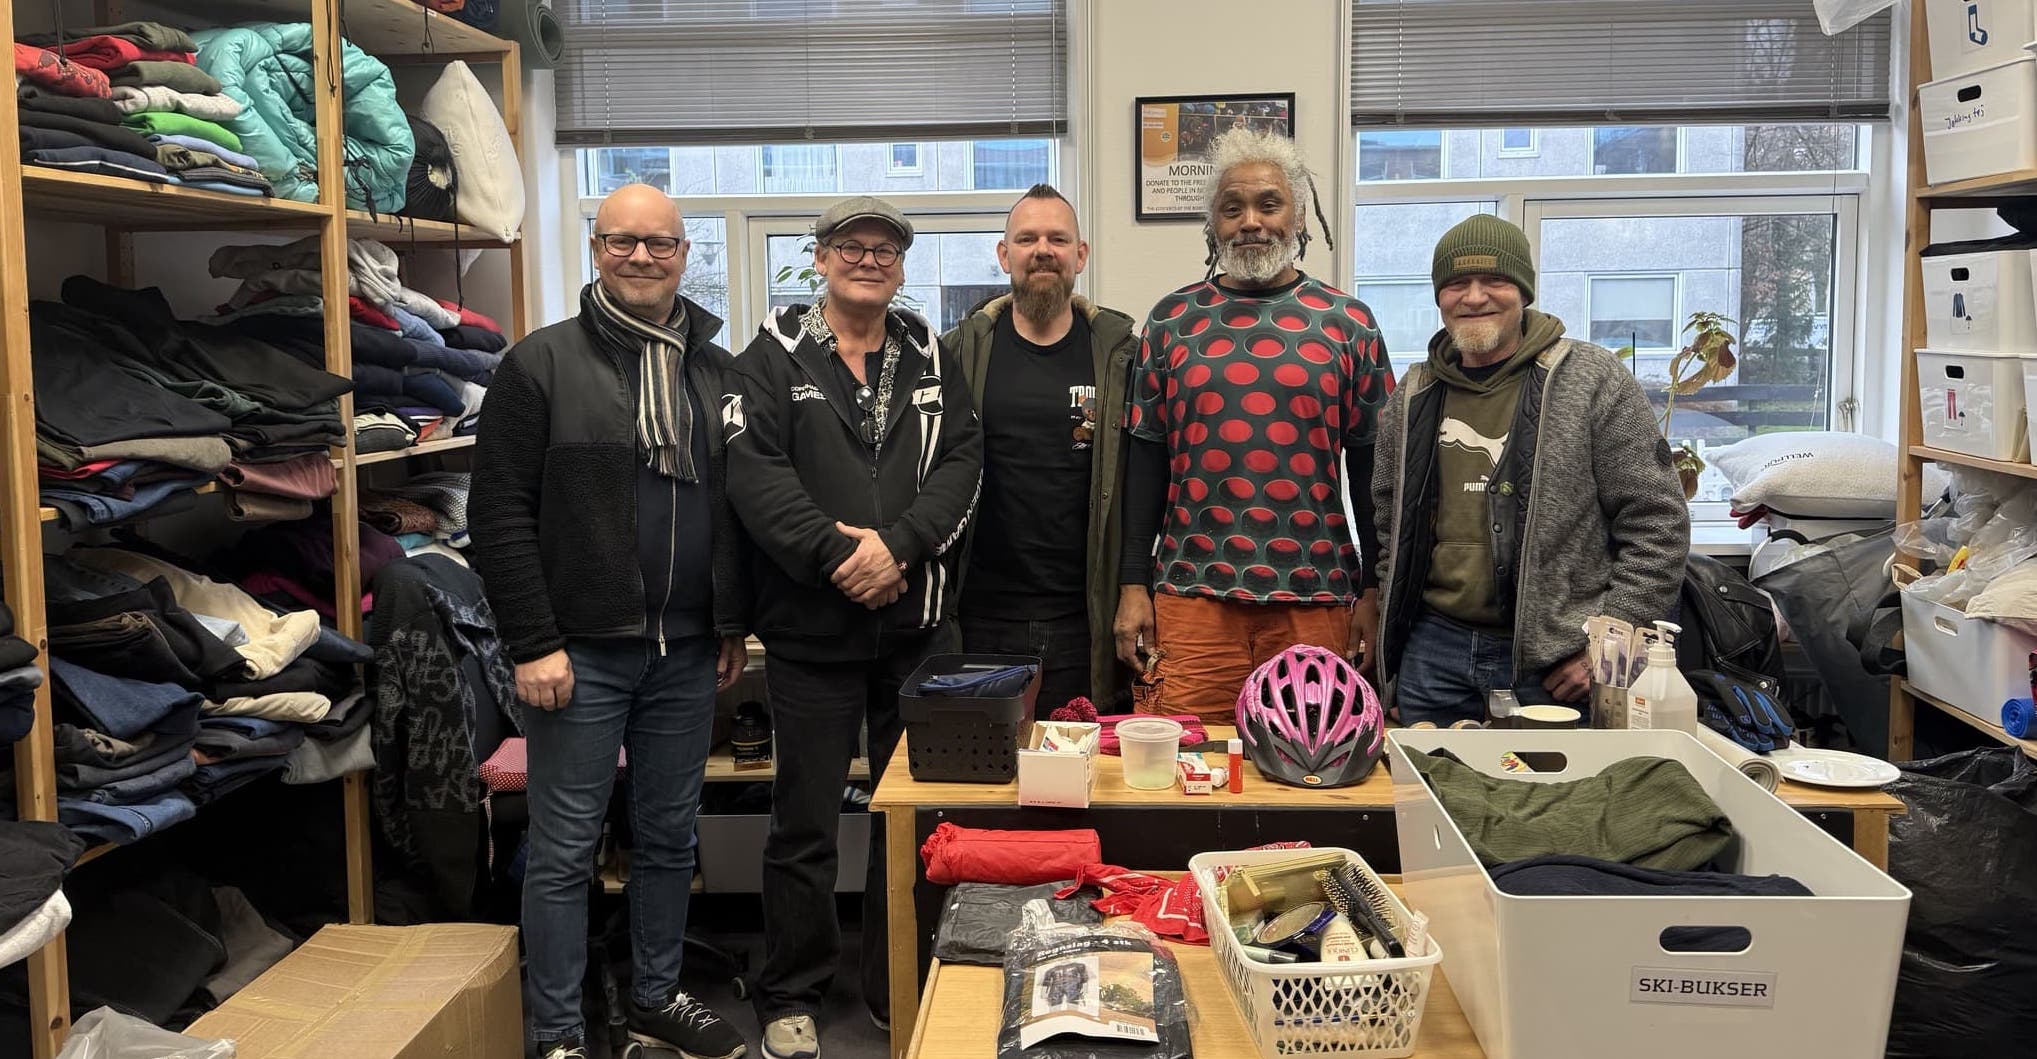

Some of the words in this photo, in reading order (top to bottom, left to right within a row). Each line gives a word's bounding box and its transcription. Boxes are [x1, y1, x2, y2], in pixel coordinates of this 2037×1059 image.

[1145, 179, 1169, 187] DONATE
[1463, 482, 1488, 492] PUM
[1638, 978, 1768, 997] SKI-BUKSER
